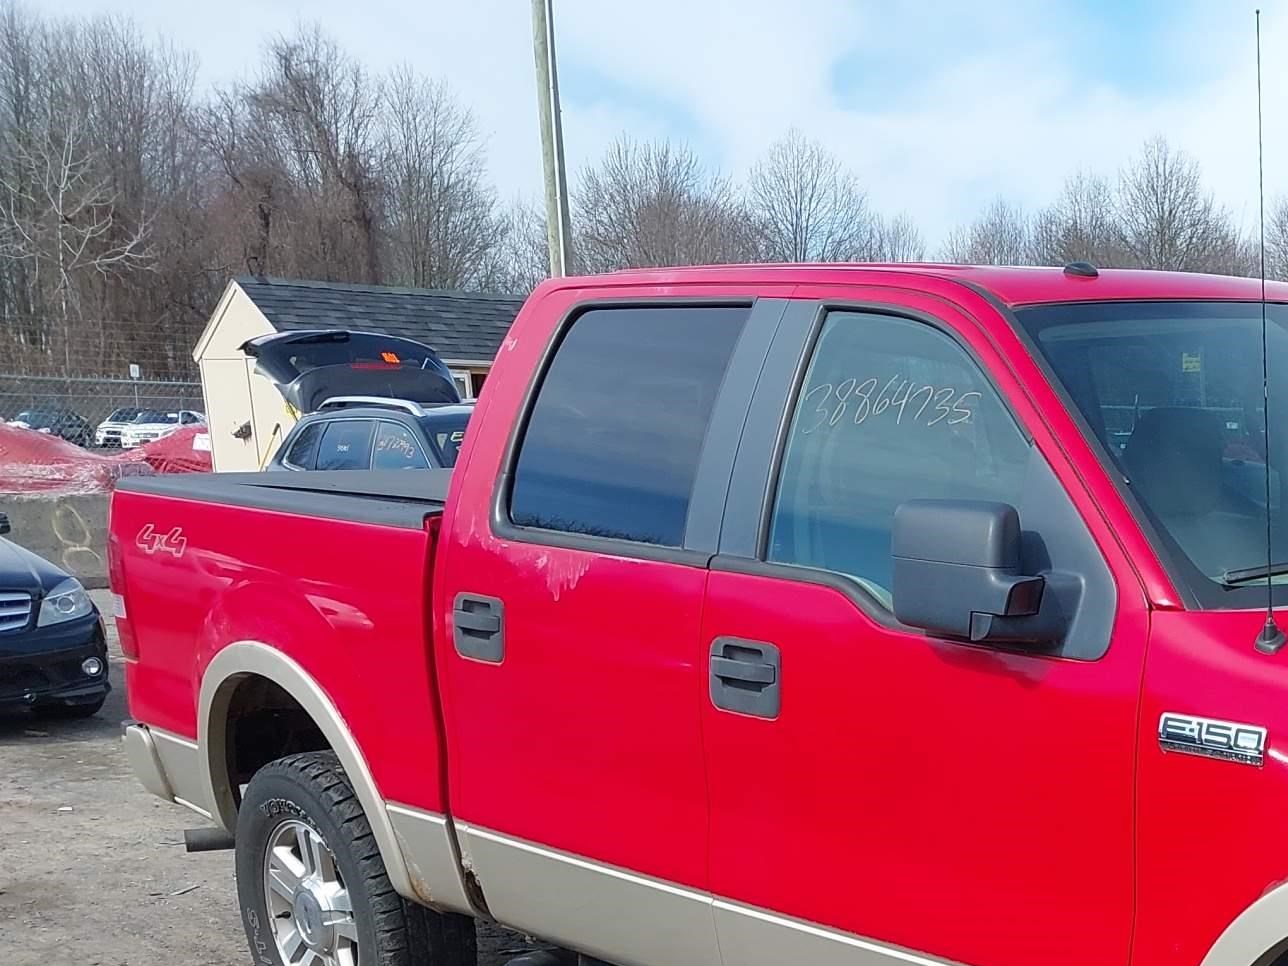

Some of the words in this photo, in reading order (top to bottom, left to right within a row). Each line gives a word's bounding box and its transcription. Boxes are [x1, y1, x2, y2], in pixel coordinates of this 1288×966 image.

[802, 374, 982, 434] 38864735
[135, 523, 187, 558] 4x4
[1161, 716, 1263, 751] F-150
